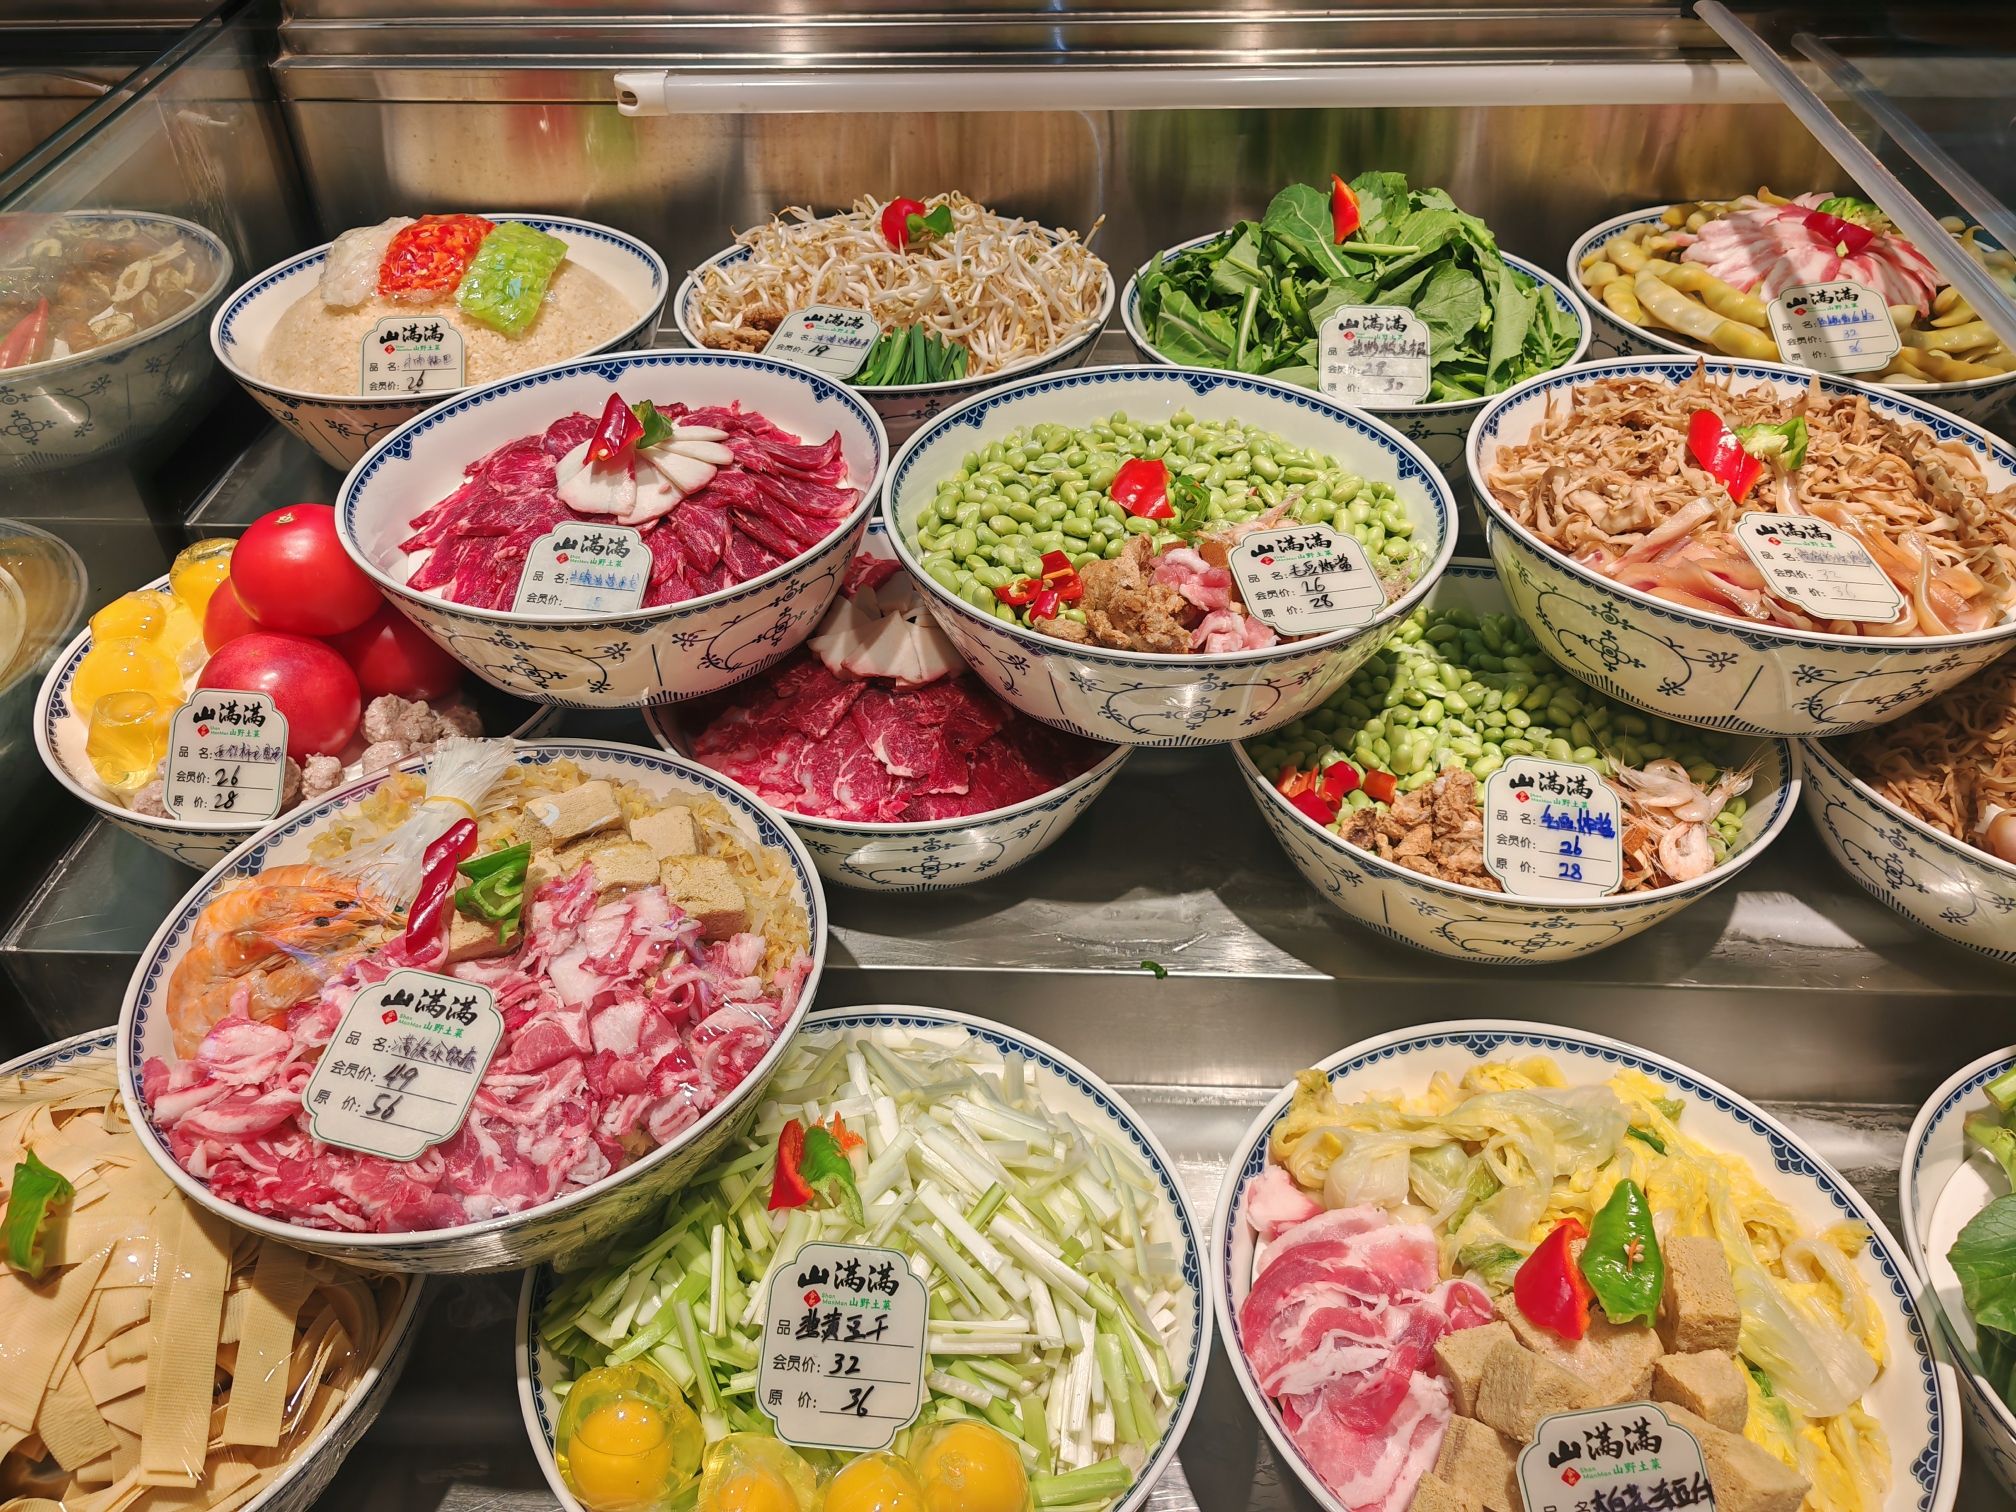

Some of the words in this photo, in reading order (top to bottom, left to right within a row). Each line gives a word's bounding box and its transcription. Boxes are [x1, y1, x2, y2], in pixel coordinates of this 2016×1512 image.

[1786, 286, 1858, 309] 山满满
[803, 313, 864, 329] 山满满
[1338, 314, 1407, 332] 山满满
[379, 323, 444, 344] 山满满
[808, 344, 830, 356] 19
[407, 369, 425, 390] 26
[1756, 522, 1831, 541] 山满满
[553, 533, 630, 558] 山满满
[1250, 532, 1332, 557] 山满满
[1309, 594, 1333, 608] 28
[193, 700, 266, 727] 山满满
[177, 770, 210, 784] 会员价：
[215, 765, 240, 786] 26
[1509, 770, 1593, 799] 山满满
[214, 790, 239, 809] 28
[1496, 833, 1536, 849] 会员价：
[1559, 835, 1583, 855] 26
[1559, 862, 1583, 880] 28
[380, 988, 478, 1026] 山满满
[423, 1021, 464, 1039] 山野土菜
[330, 1060, 376, 1082] 会员价：
[383, 1063, 419, 1091] 49
[365, 1092, 403, 1120] 56
[798, 1257, 899, 1297] 山满满
[849, 1297, 891, 1310] 山野土菜
[773, 1353, 821, 1373] 会员价：
[828, 1353, 860, 1375] 32
[841, 1385, 874, 1416] 36
[1548, 1416, 1662, 1469] 山满满
[1613, 1458, 1662, 1475] 山野土菜
